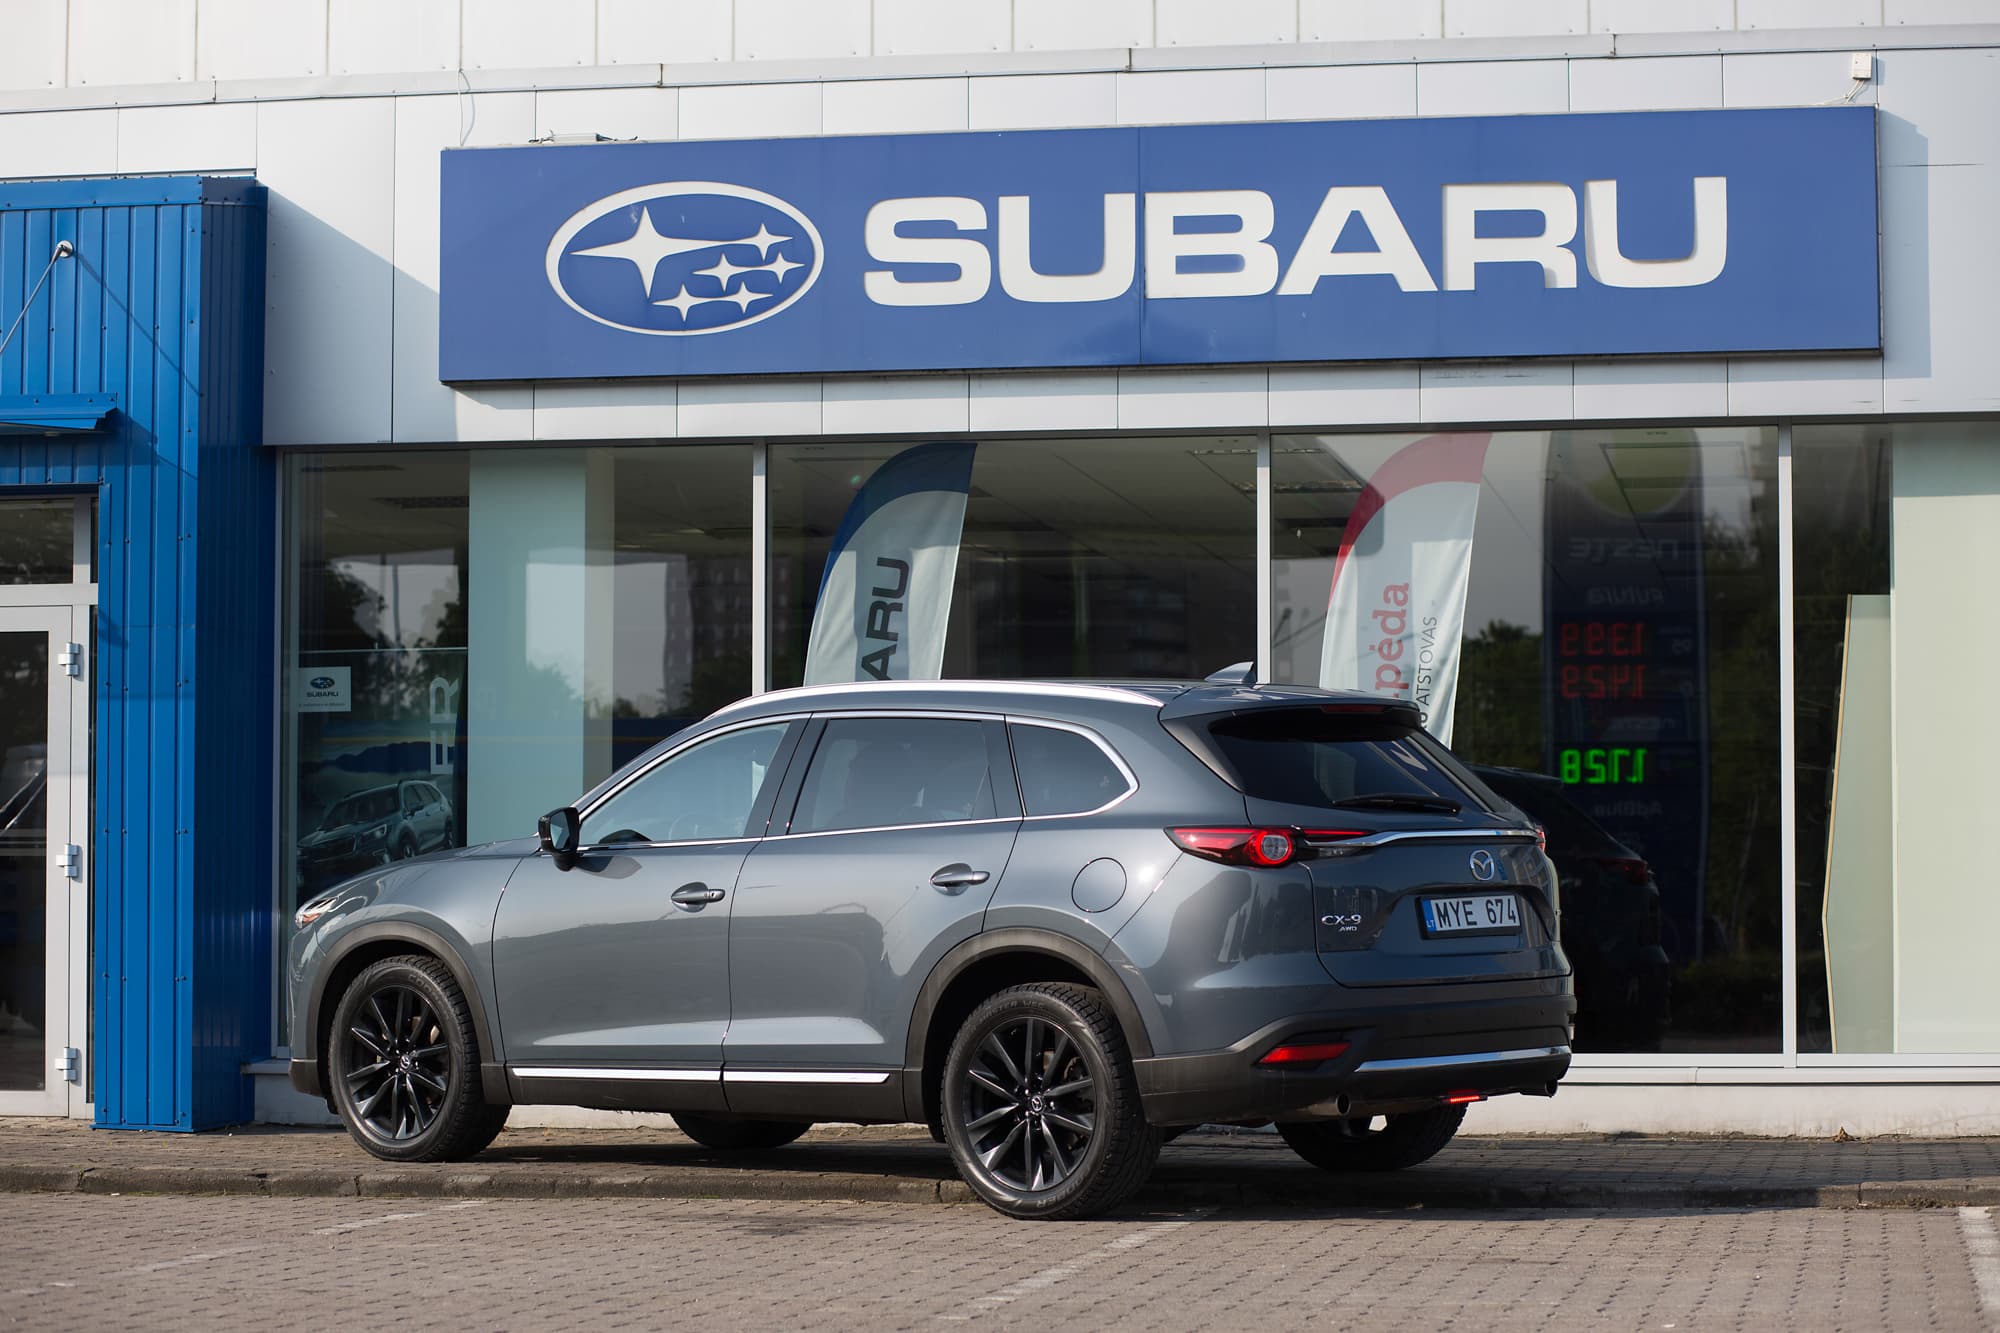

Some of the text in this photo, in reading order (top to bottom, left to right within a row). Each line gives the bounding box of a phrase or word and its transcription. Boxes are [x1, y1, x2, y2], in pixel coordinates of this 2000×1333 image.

[864, 177, 1728, 307] SUBARU
[1369, 582, 1410, 698] pėda
[1415, 616, 1438, 706] ATSTOVAS
[1321, 914, 1362, 926] CX-9
[1426, 899, 1516, 929] LT MYE 674
